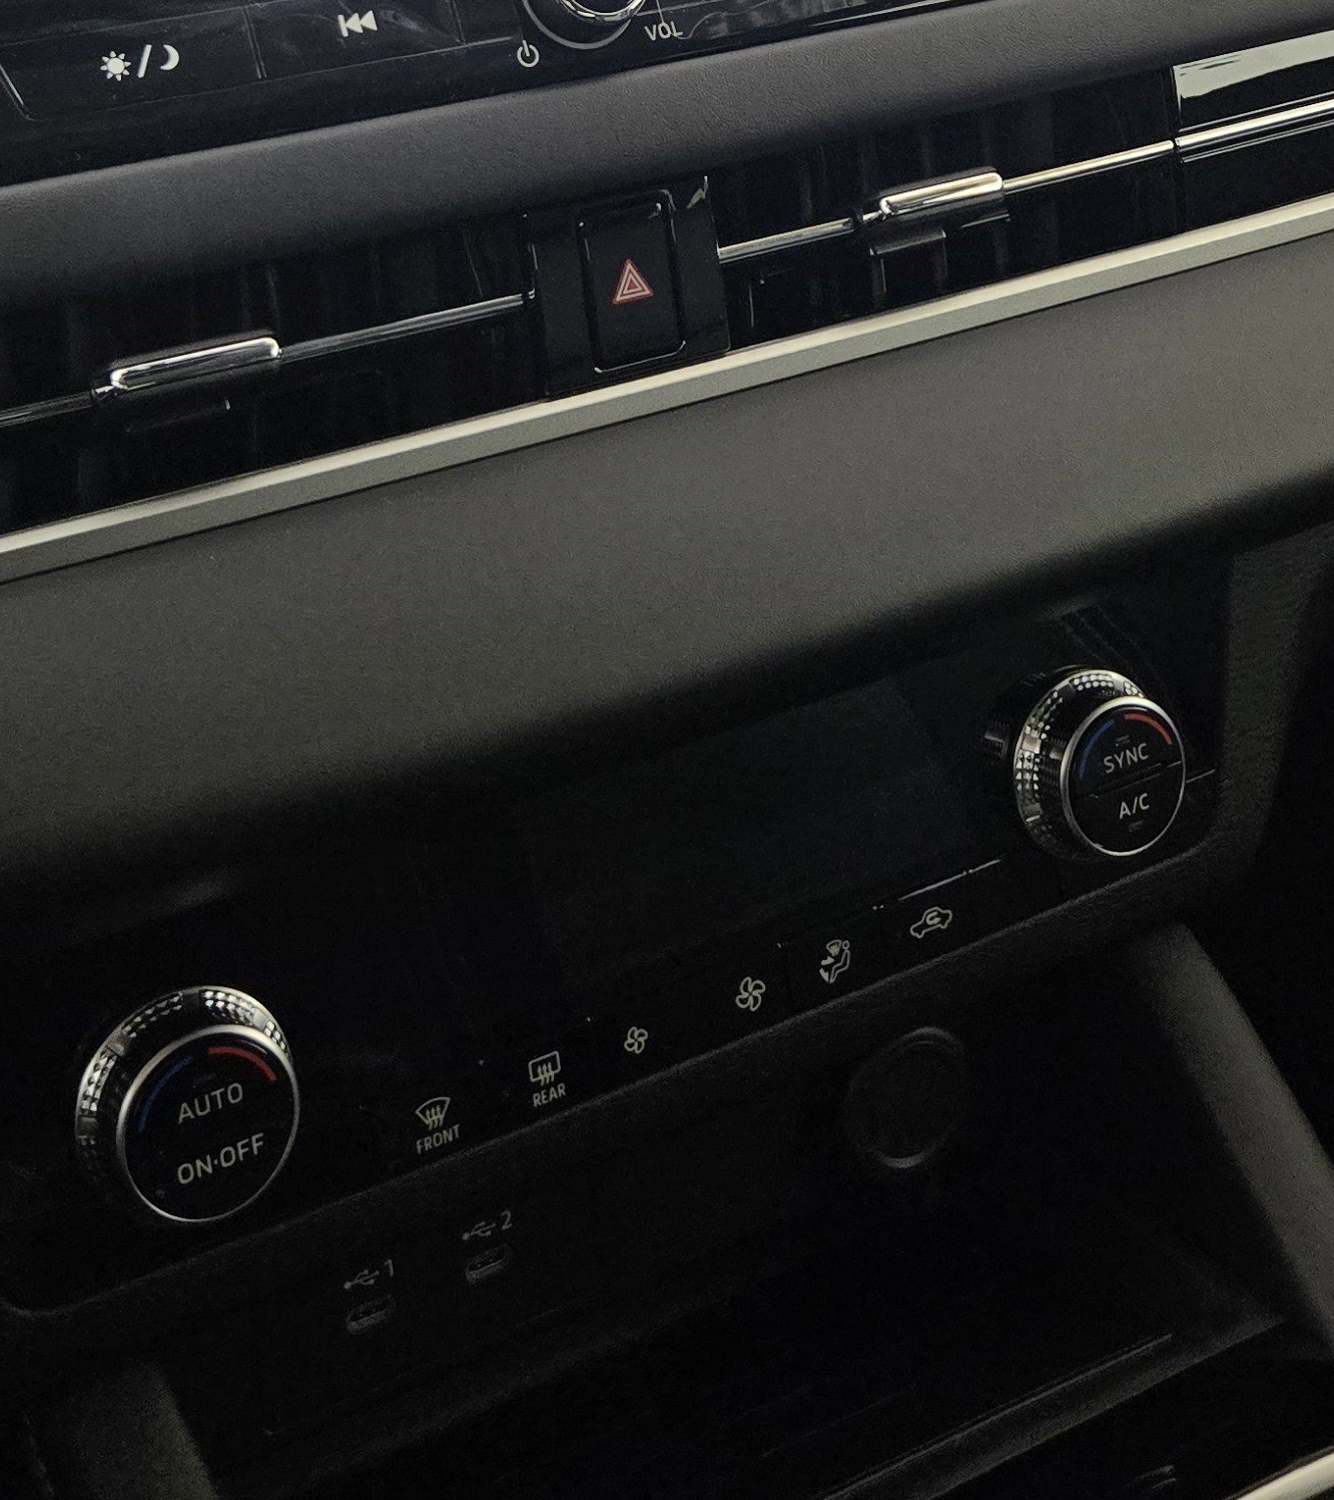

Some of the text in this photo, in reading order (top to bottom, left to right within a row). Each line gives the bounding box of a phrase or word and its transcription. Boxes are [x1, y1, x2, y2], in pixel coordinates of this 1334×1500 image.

[644, 21, 683, 41] VOL
[1102, 743, 1150, 774] SYNC
[1118, 792, 1150, 819] A/C
[177, 1081, 245, 1124] AUTO
[531, 1082, 567, 1108] REAR
[415, 1124, 461, 1154] FRONT
